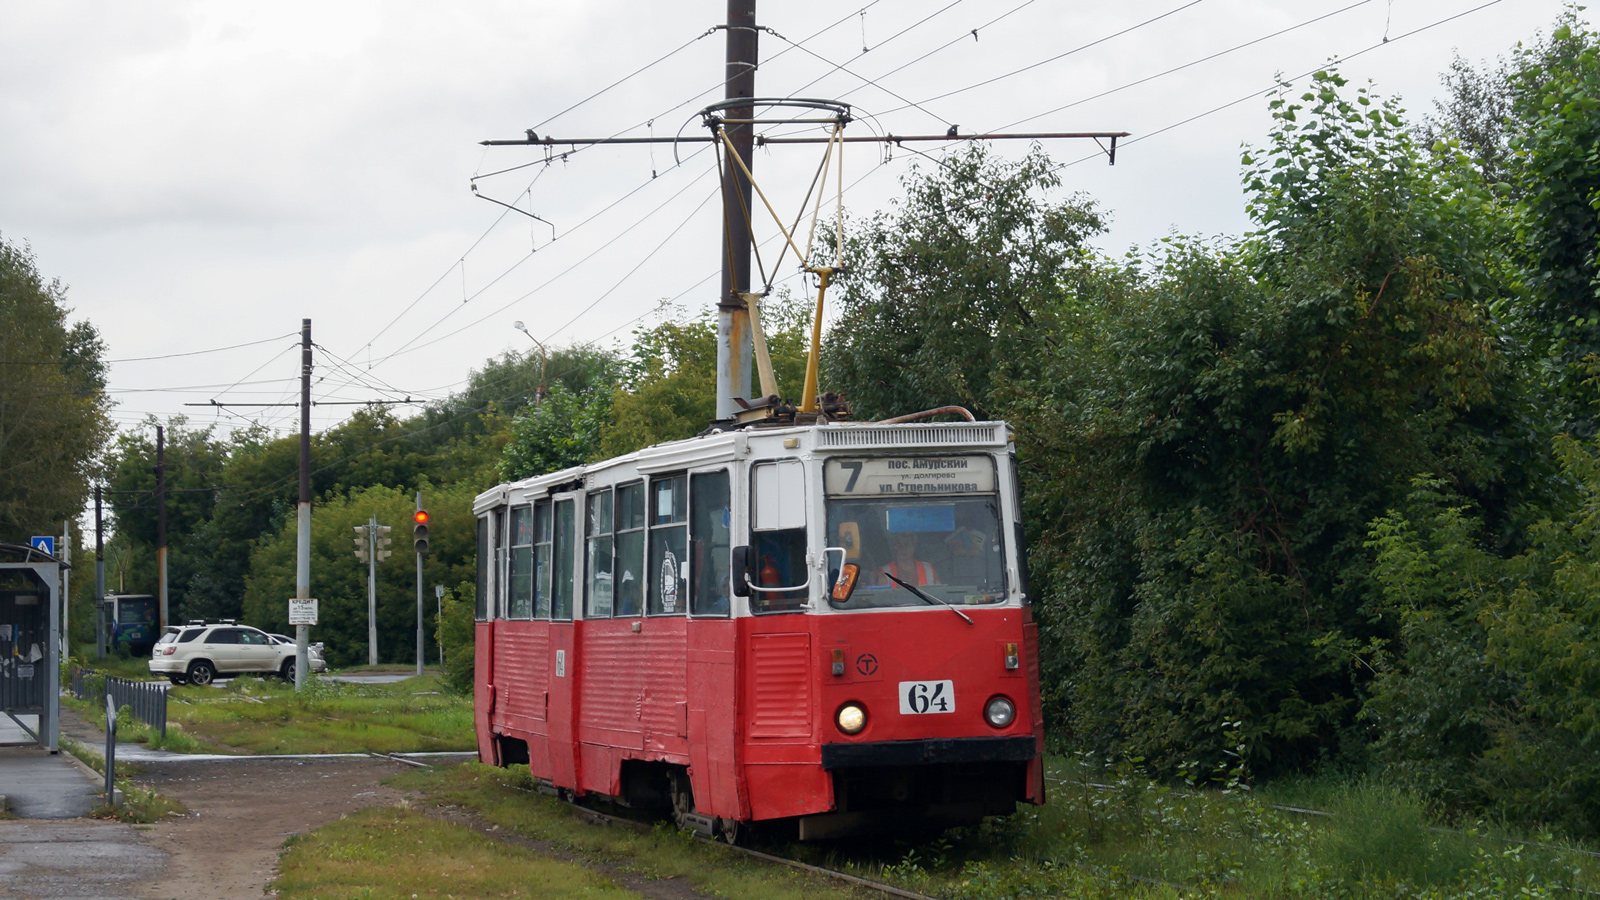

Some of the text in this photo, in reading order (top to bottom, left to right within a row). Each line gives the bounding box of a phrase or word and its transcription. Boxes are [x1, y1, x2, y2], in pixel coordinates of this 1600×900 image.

[888, 458, 968, 470] пос. Амурский
[840, 461, 863, 493] 7
[879, 481, 978, 493] ул. Стрельникова
[908, 682, 948, 714] 64
